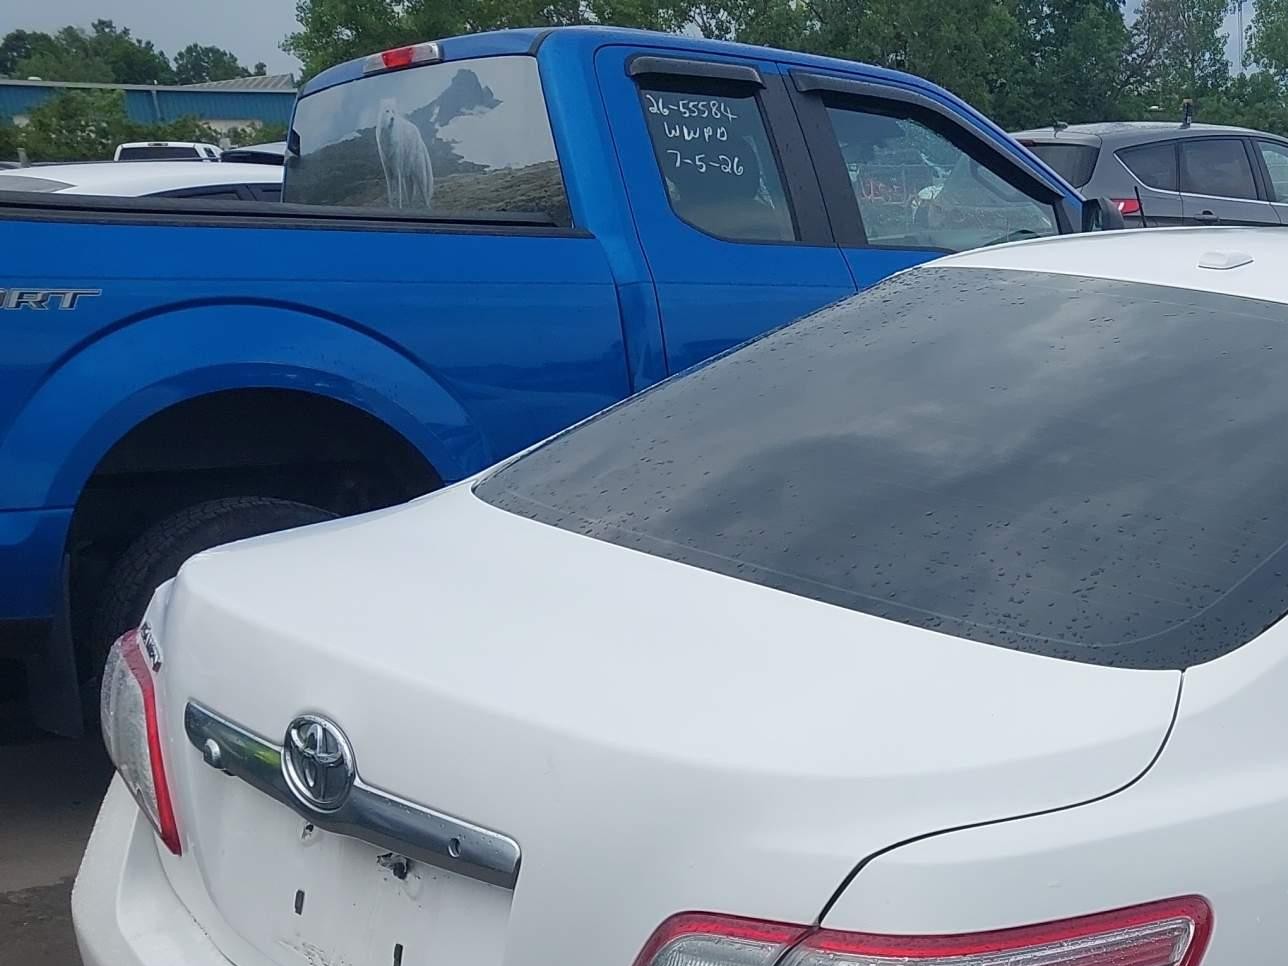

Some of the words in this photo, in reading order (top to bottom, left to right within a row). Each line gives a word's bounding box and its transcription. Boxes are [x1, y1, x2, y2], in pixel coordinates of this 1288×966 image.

[646, 94, 738, 121] 26-55584
[667, 150, 744, 175] 7-5-26
[0, 288, 103, 311] RT
